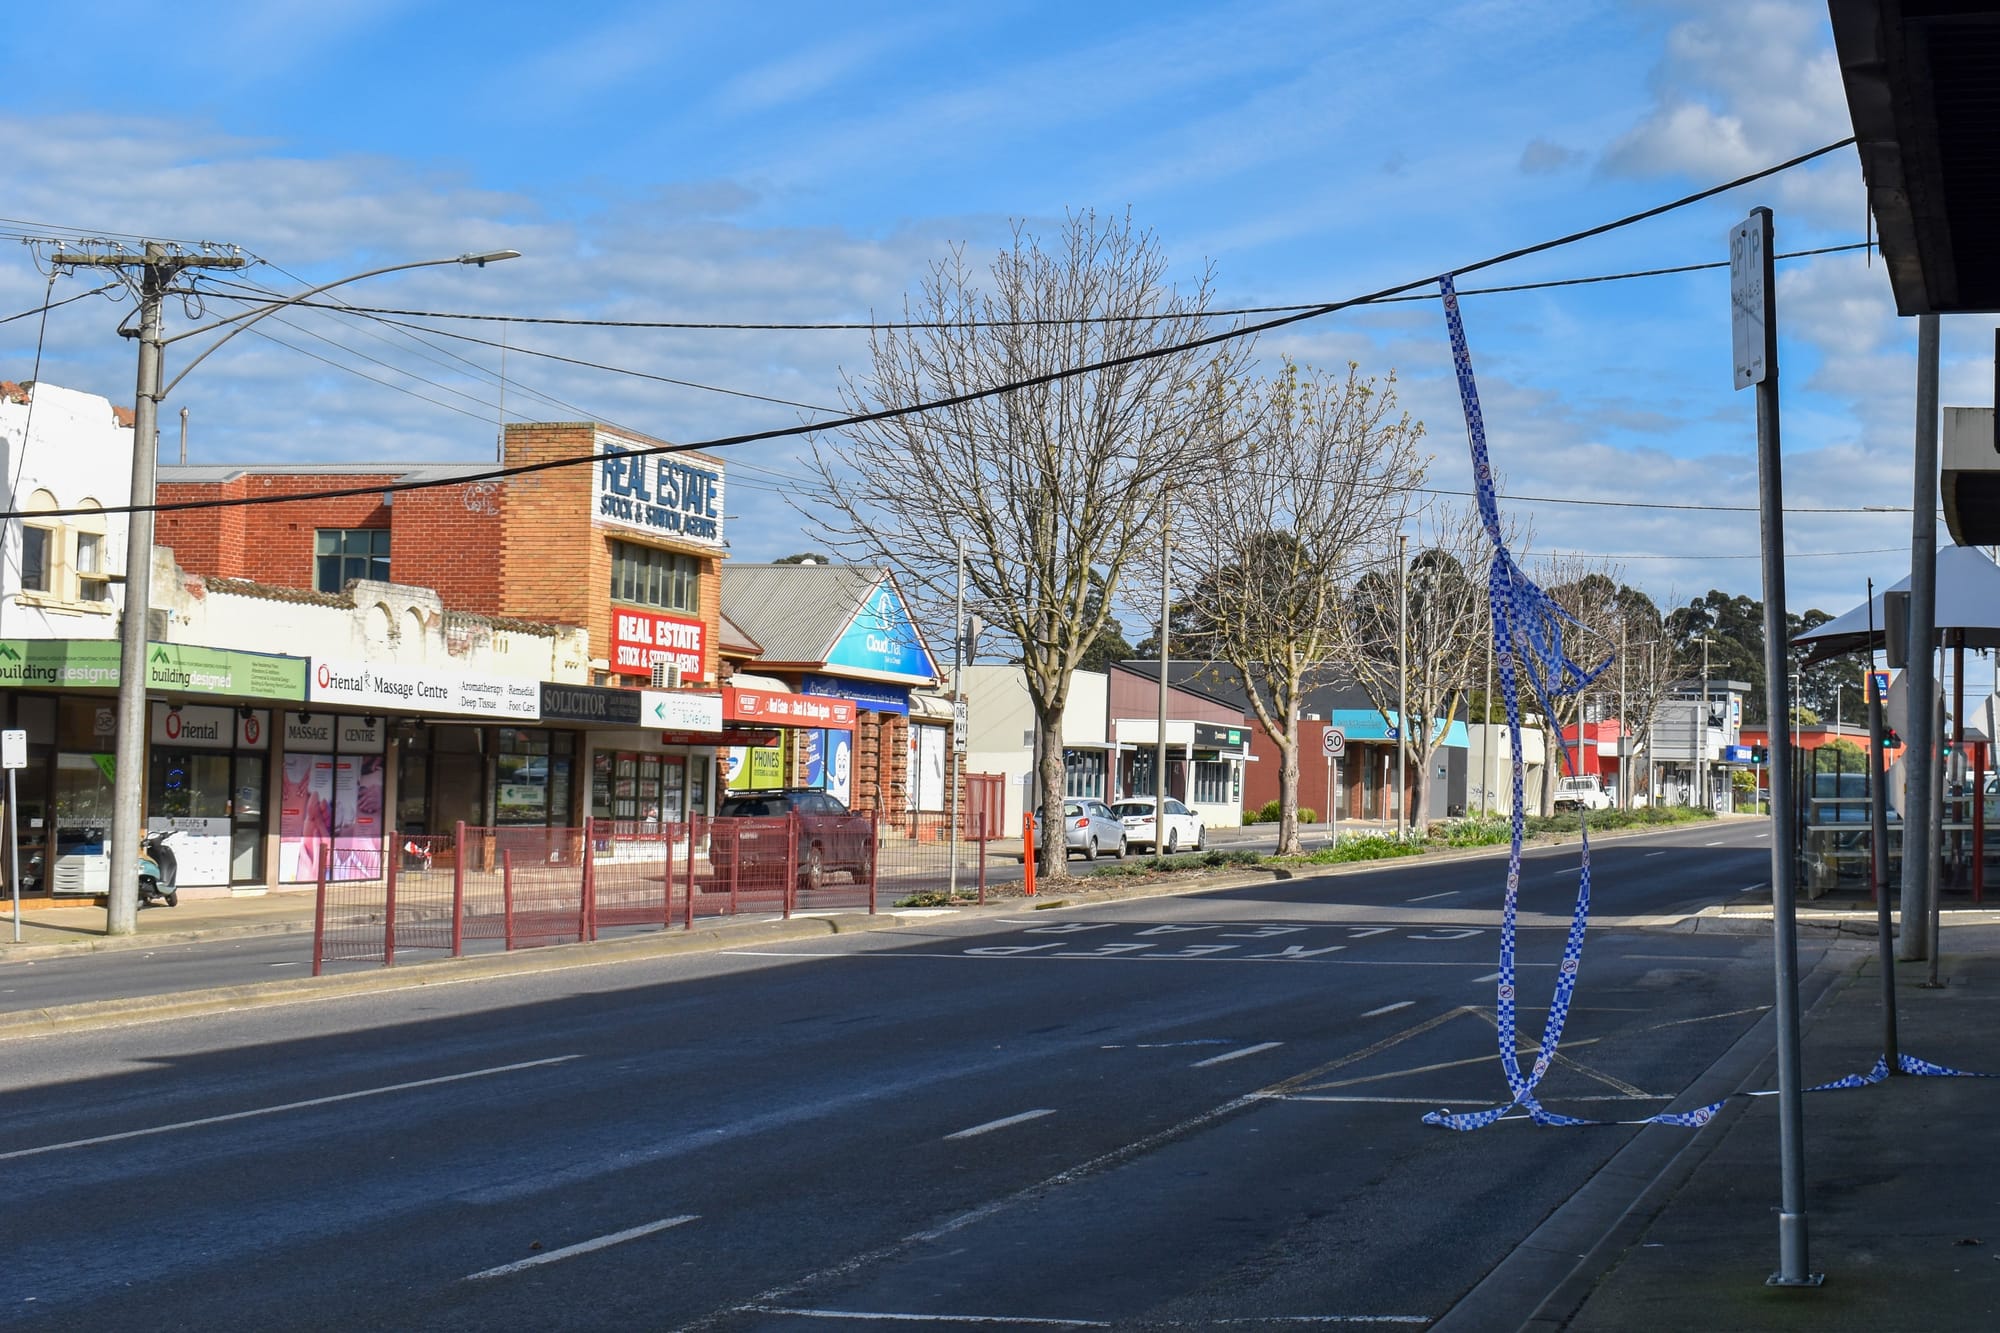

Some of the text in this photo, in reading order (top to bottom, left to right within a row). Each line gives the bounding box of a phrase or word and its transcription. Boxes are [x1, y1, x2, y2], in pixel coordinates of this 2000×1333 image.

[601, 442, 719, 518] REAL ESTATE
[600, 494, 633, 521] STOCK
[635, 501, 643, 523] &
[682, 514, 717, 540] AGENTS
[618, 614, 701, 651] REAL ESTATE
[617, 645, 640, 667] STOCK
[640, 648, 648, 668] &
[318, 663, 363, 692] Oriental
[374, 676, 414, 699] Massage
[417, 681, 448, 699] Centre
[461, 695, 477, 710] Deep
[544, 689, 606, 716] SOLICITOR
[955, 705, 966, 719] ONE
[166, 710, 219, 740] Oriental
[288, 725, 329, 741] MASSAGE
[344, 728, 376, 742] CENTRE
[1326, 735, 1341, 747] 50
[754, 750, 779, 768] PHONES
[1502, 1010, 1510, 1042] POLICE
